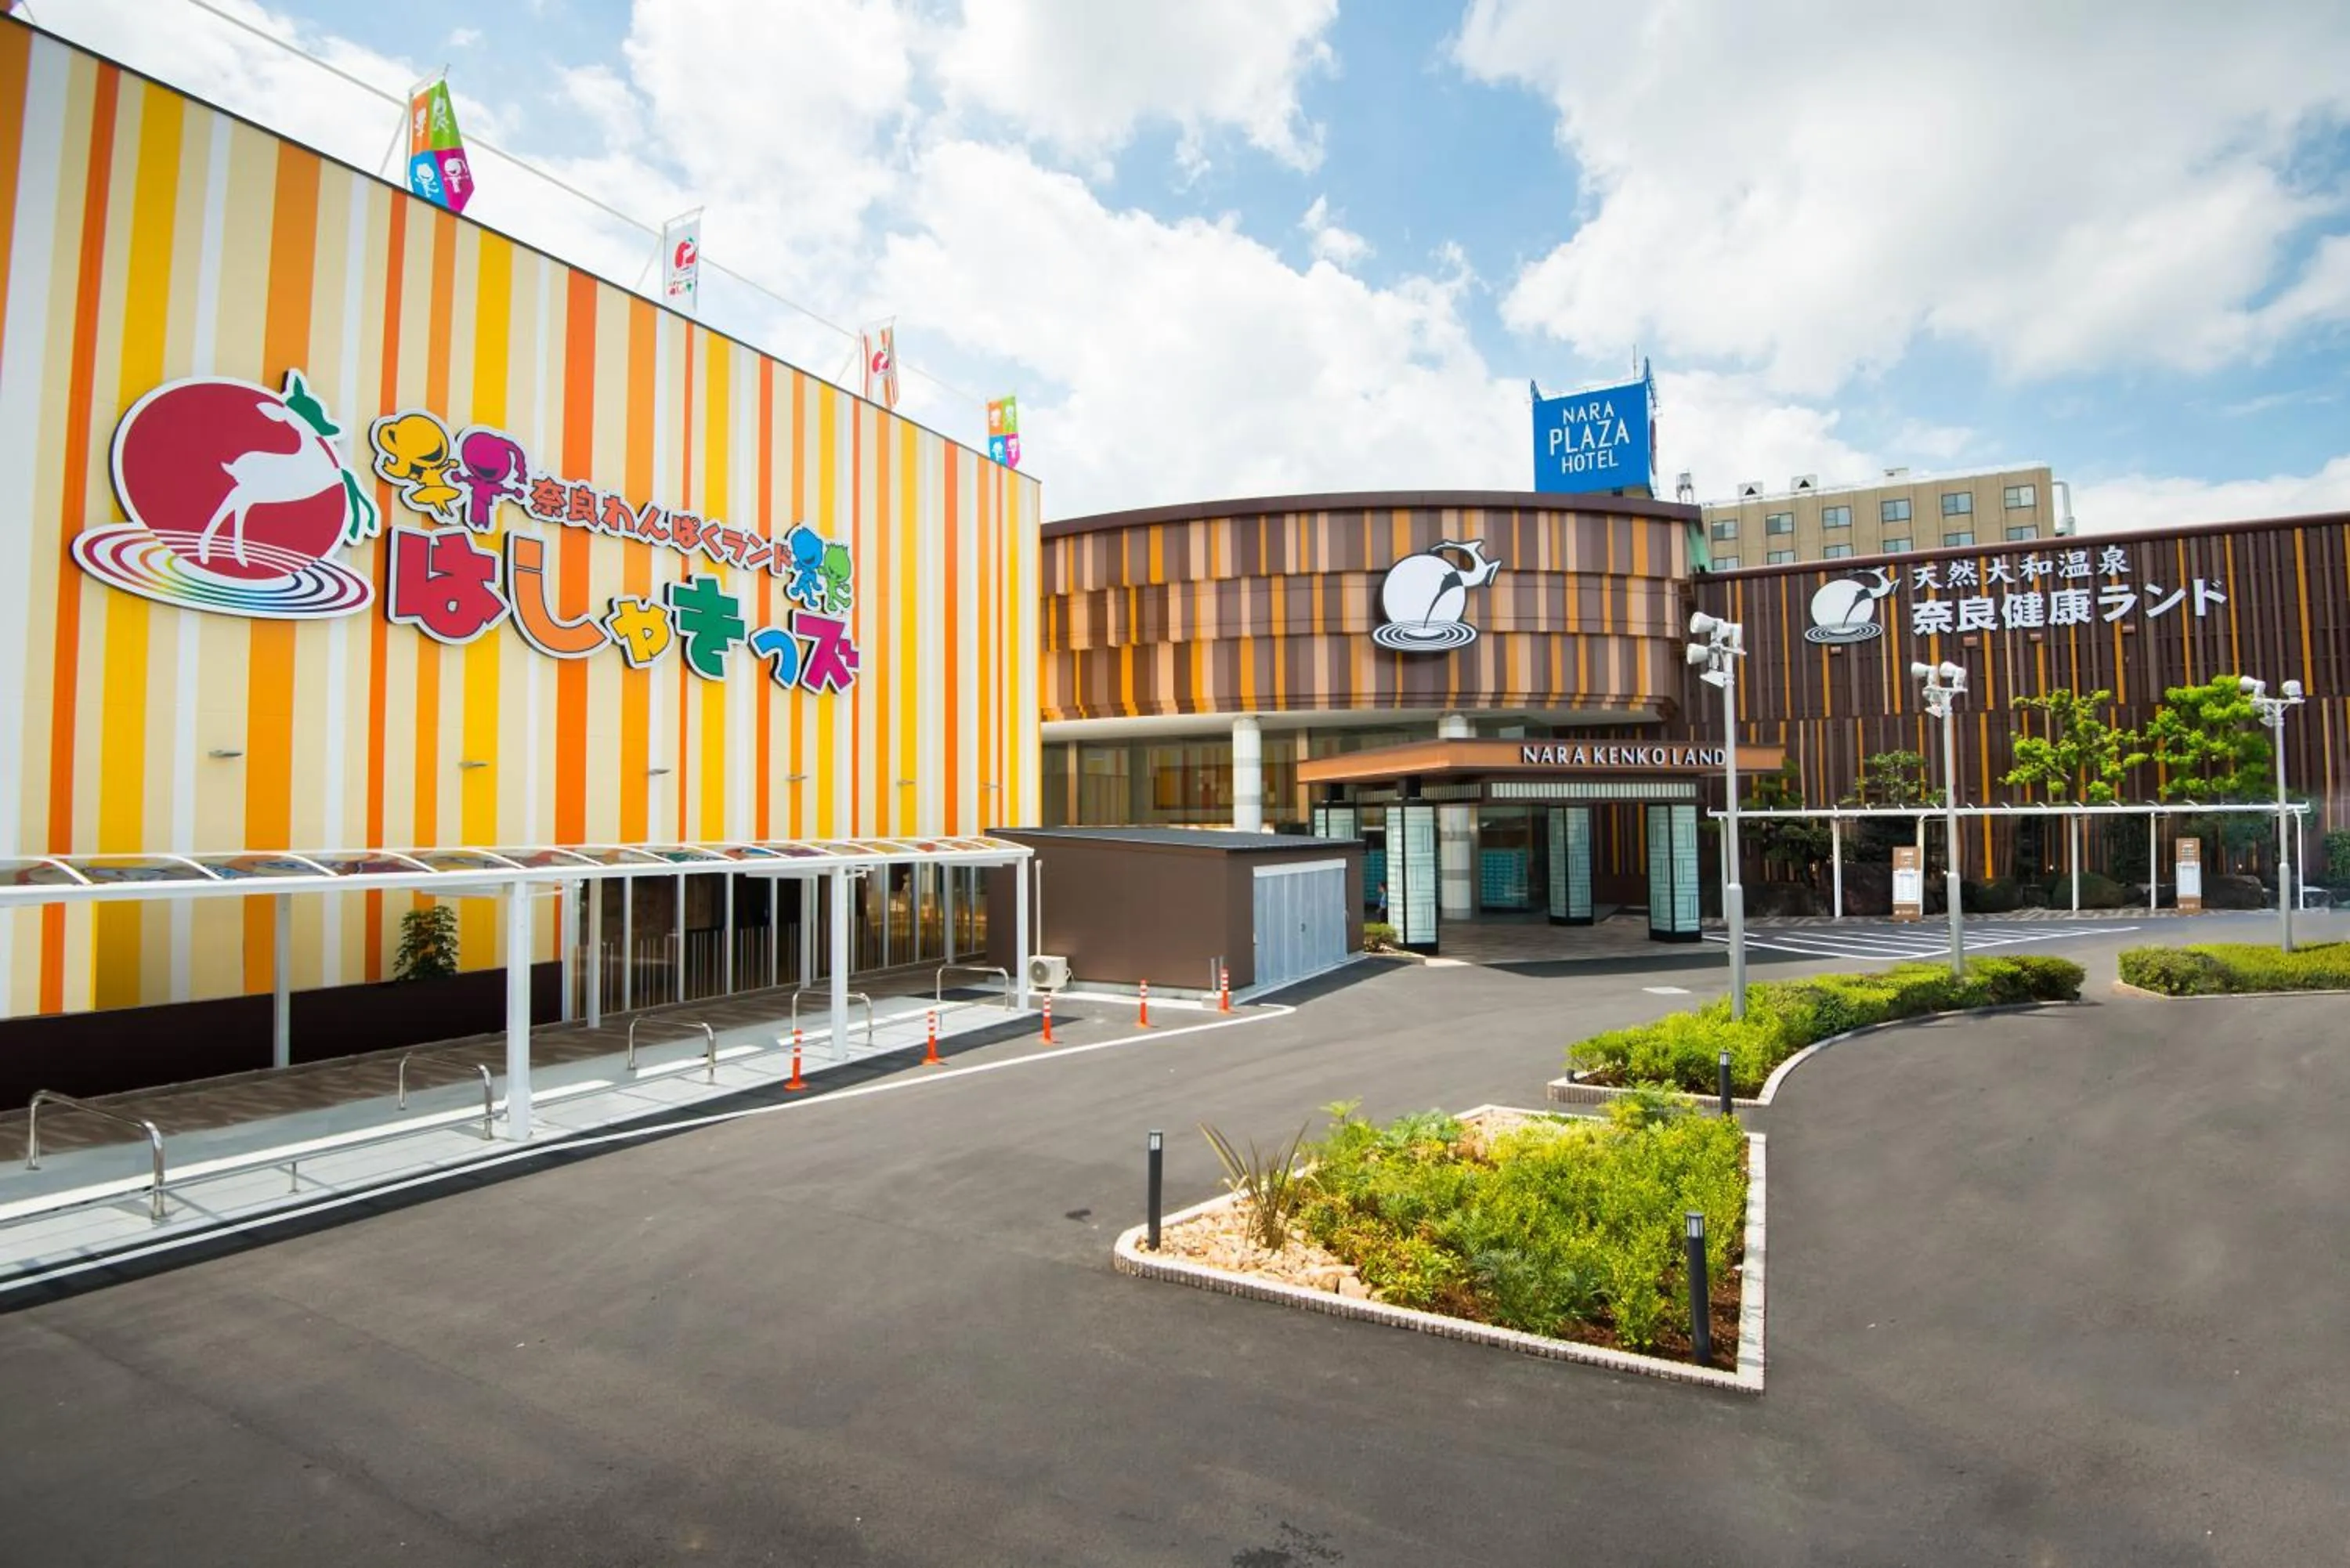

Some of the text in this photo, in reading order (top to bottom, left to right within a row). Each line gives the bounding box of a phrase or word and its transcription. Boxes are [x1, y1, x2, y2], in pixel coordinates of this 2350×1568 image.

[1562, 400, 1615, 425] NARA
[1549, 417, 1630, 457] PLAZA
[1561, 448, 1619, 475] HOTEL
[531, 475, 794, 574] 奈良わんぱくランド
[1912, 544, 2131, 591] 天然大和温泉
[1911, 578, 2228, 636] 奈良健康ランド
[1521, 746, 1726, 766] NARA KENKO LAND
